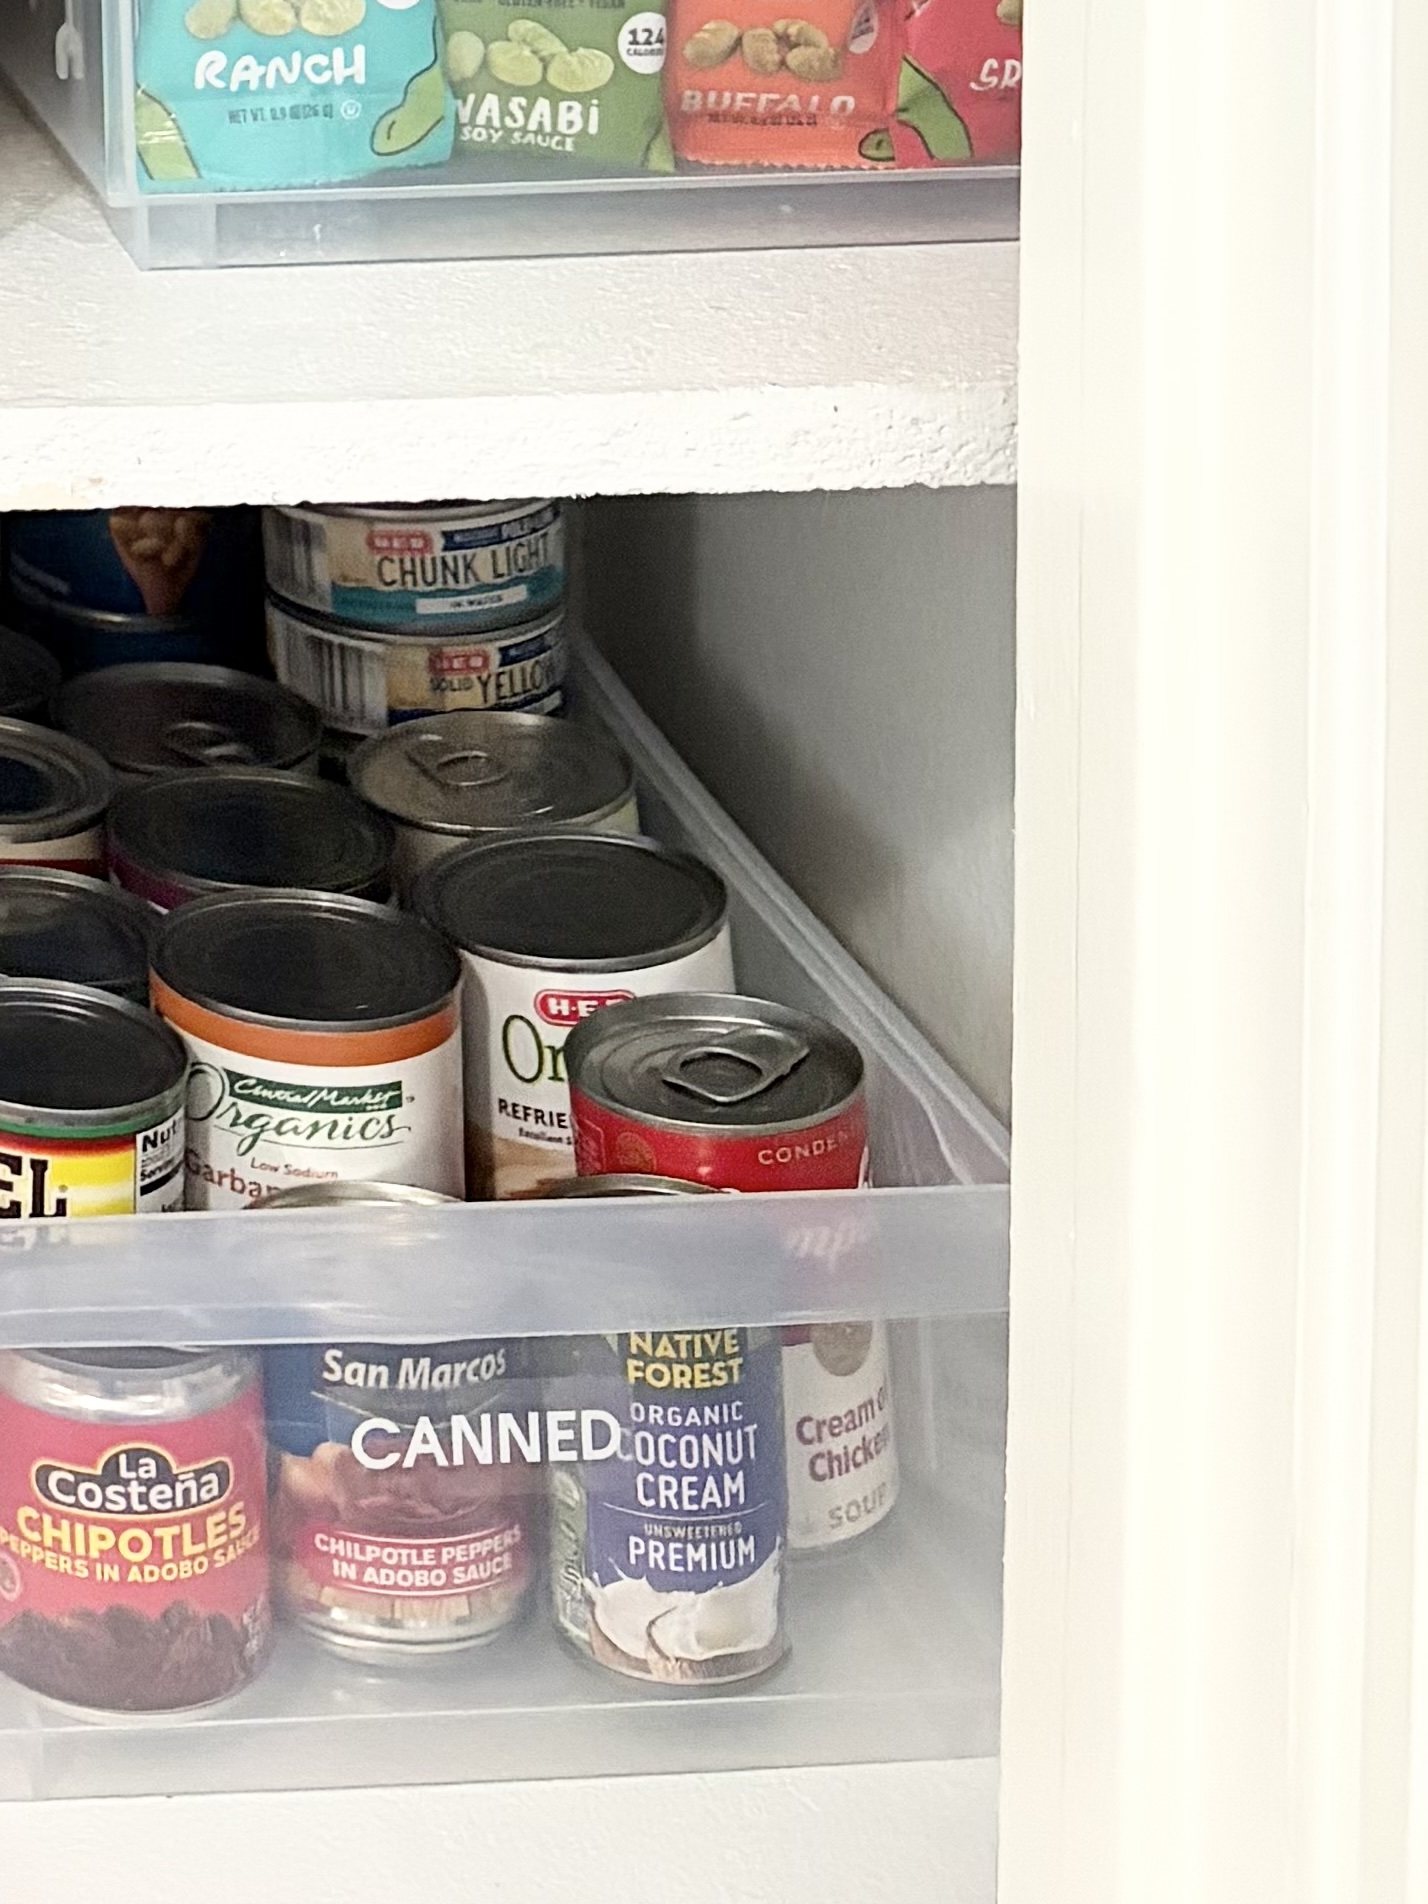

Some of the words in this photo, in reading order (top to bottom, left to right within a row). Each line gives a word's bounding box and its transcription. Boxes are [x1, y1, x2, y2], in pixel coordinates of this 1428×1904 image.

[194, 45, 366, 92] RANCH
[378, 555, 479, 587] CHUNK
[490, 531, 550, 580] LIGHT
[629, 1331, 738, 1357] NATIVE
[323, 1348, 389, 1384] San
[398, 1346, 506, 1391] Marcos
[627, 1358, 744, 1388] FOREST
[630, 1402, 743, 1425] ORGANIC
[795, 1394, 876, 1446] Cream
[349, 1408, 624, 1471] CANNED
[617, 1424, 758, 1468] COCONUT
[119, 1454, 156, 1480] La
[48, 1473, 220, 1510] Costeña
[636, 1471, 746, 1511] CREAM
[18, 1502, 246, 1562] CHIPOTLES
[314, 1532, 436, 1566] CHILPOTLE
[442, 1527, 521, 1565] PEPPERS
[0, 1526, 89, 1579] PEPPERS
[96, 1562, 119, 1582] IN
[127, 1558, 208, 1583] ADOBO
[214, 1524, 261, 1574] SAUCE
[334, 1560, 357, 1580] IN
[362, 1563, 446, 1588] ADOBO
[452, 1552, 511, 1582] SAUCE
[629, 1536, 755, 1572] PREMIUM
